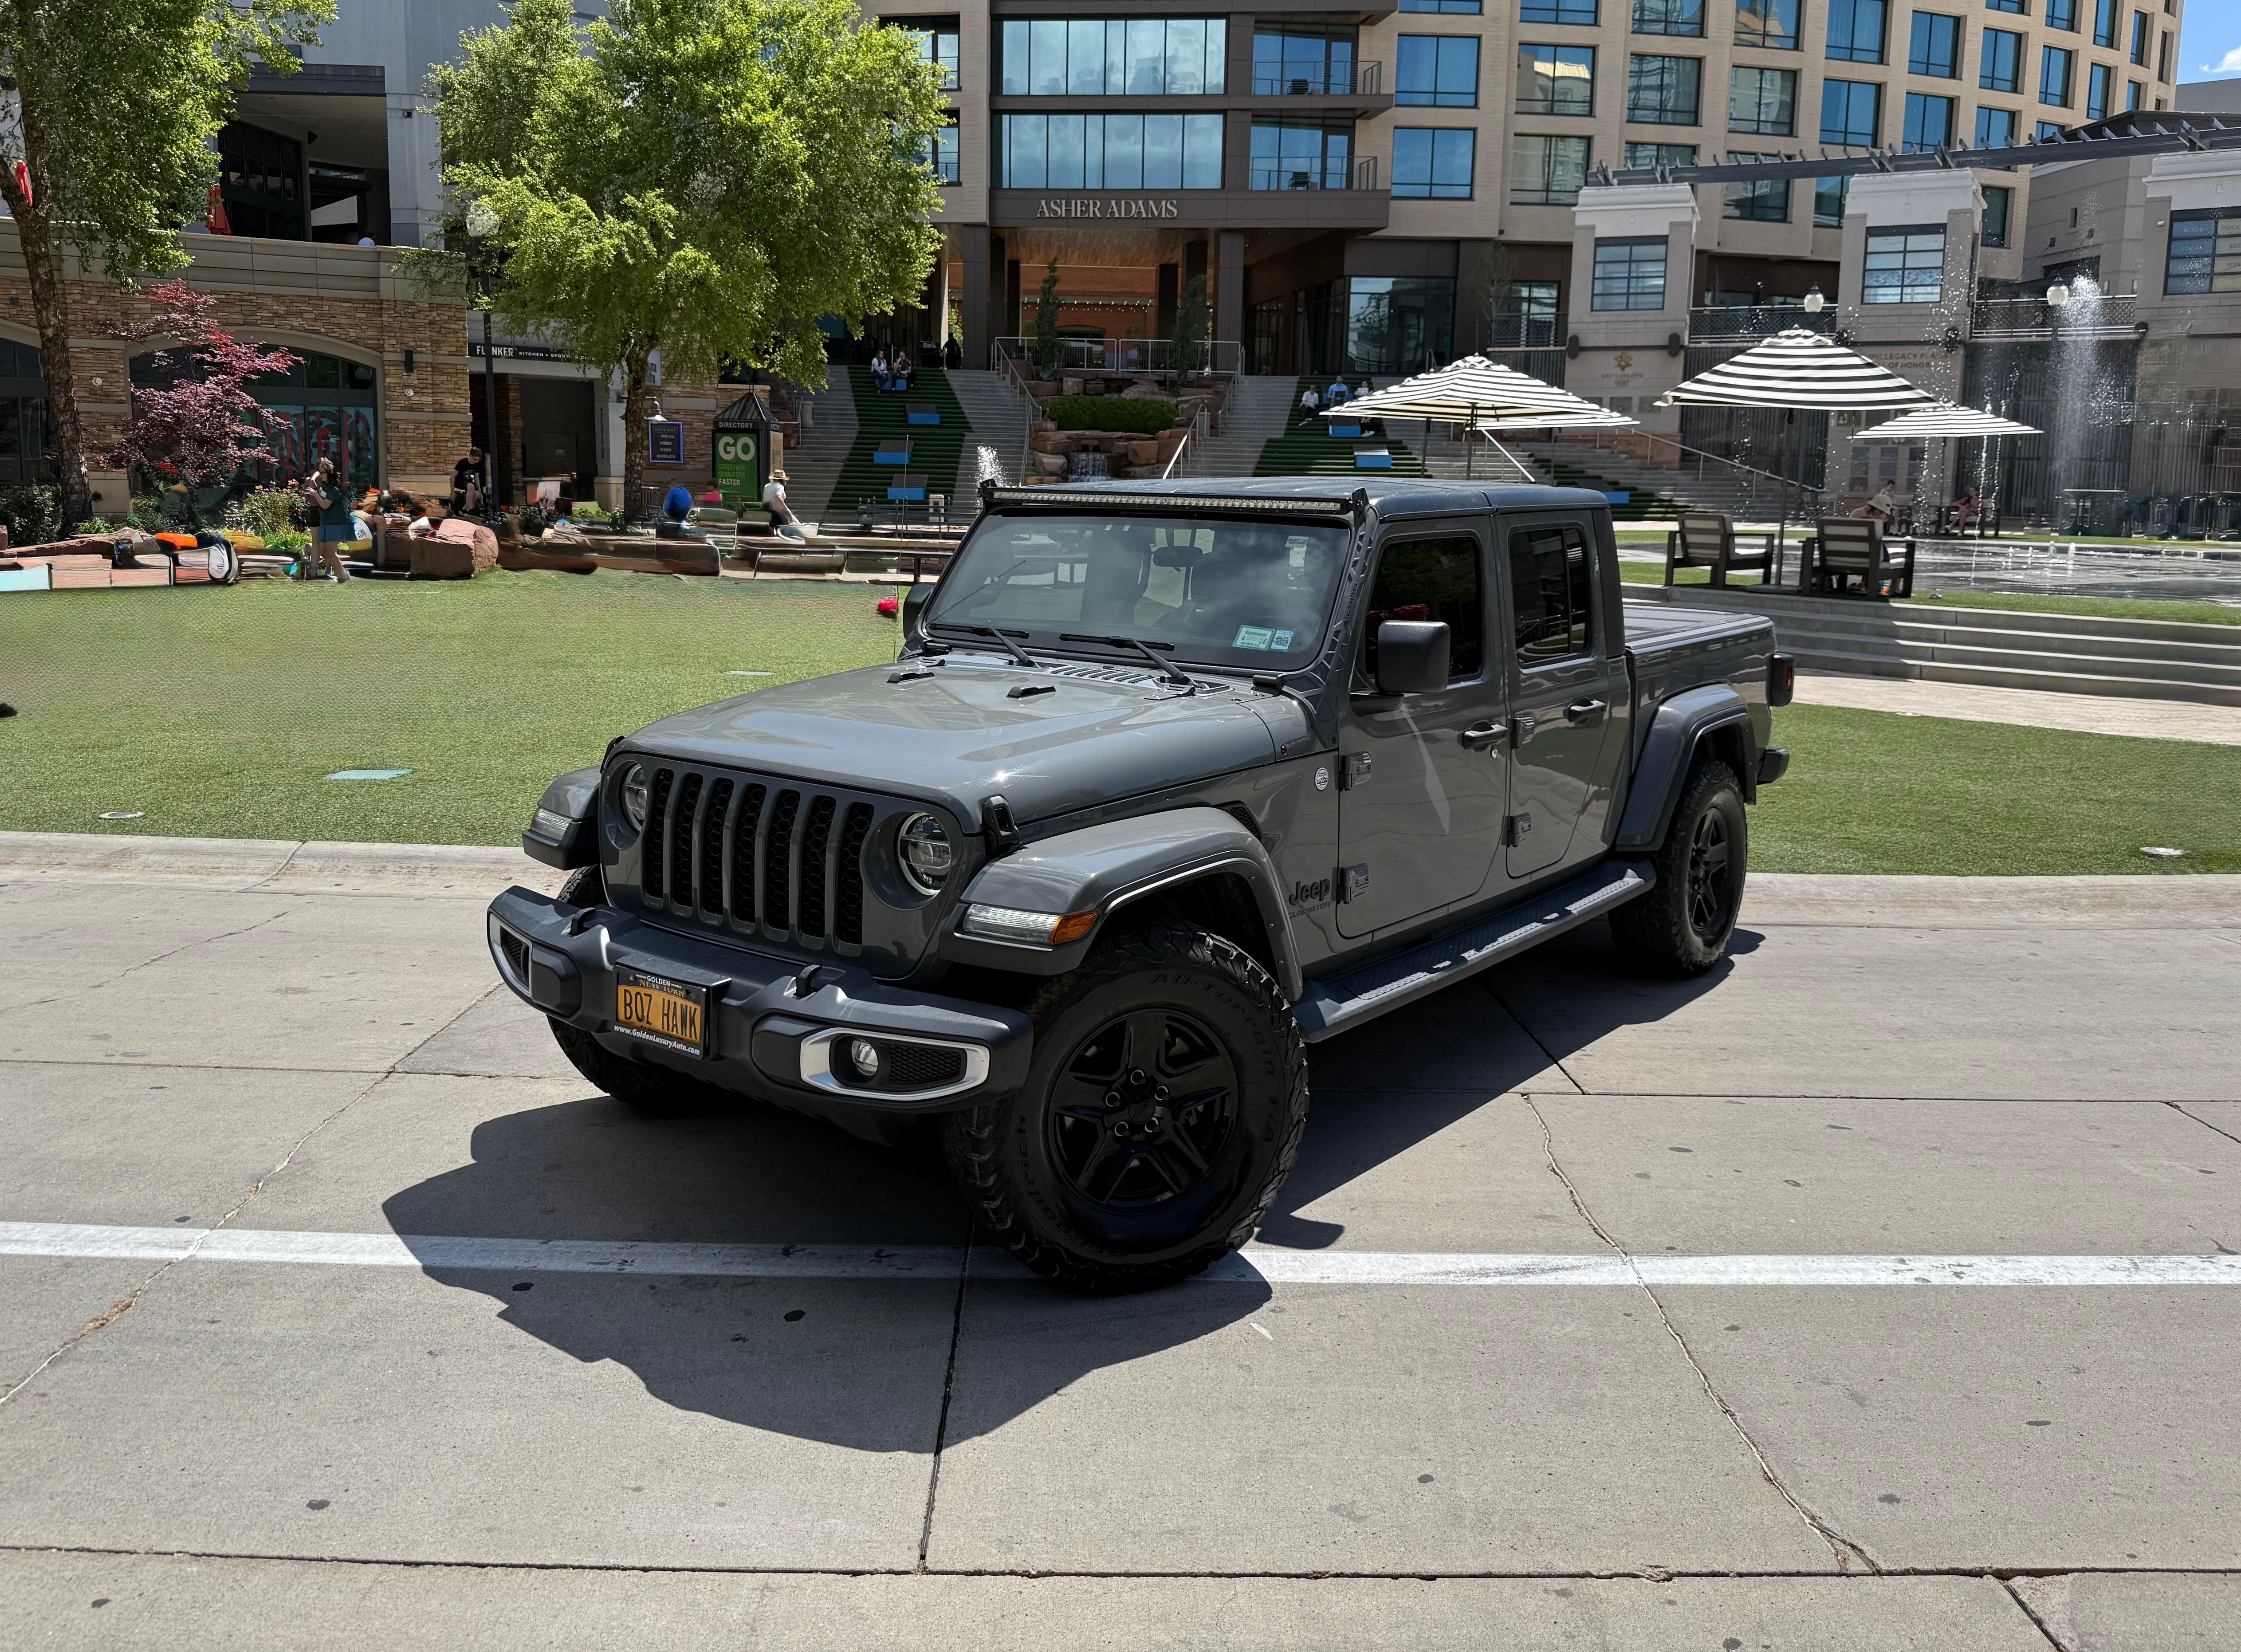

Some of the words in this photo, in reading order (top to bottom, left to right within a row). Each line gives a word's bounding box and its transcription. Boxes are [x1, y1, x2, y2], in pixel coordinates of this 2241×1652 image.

[1037, 199, 1102, 218] ASHER
[1107, 199, 1178, 219] ADAMS
[476, 345, 514, 357] FLNKER
[719, 436, 755, 461] GO
[1289, 878, 1330, 905] Jeep
[1288, 901, 1330, 919] GLADIATOR
[639, 979, 660, 989] NEW
[647, 975, 671, 987] GOLDEN
[624, 989, 653, 1025] BOZ
[662, 998, 698, 1040] HAWK
[614, 1025, 700, 1056] www.GoldenLuxuryAuto.com
